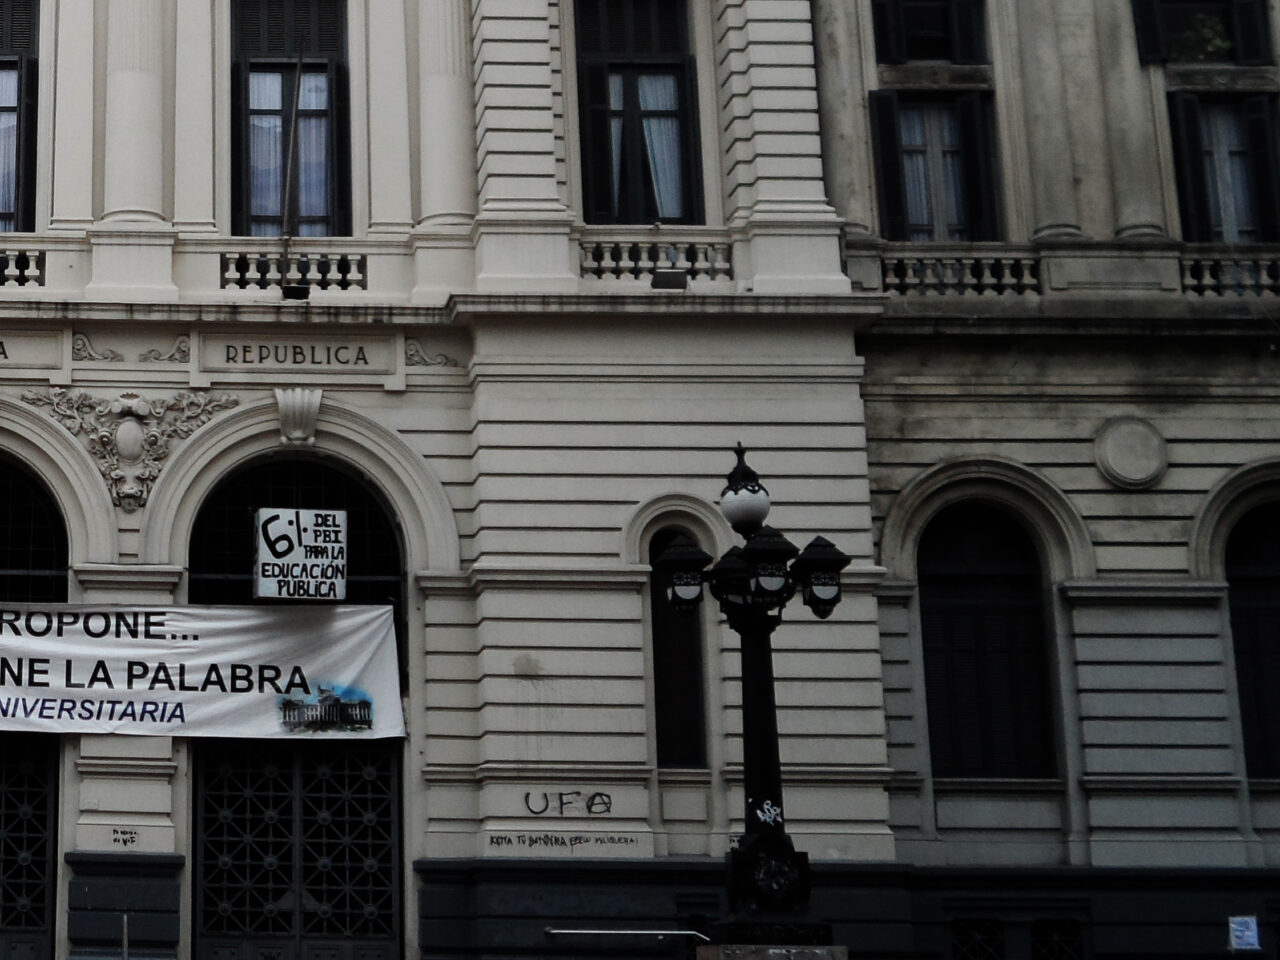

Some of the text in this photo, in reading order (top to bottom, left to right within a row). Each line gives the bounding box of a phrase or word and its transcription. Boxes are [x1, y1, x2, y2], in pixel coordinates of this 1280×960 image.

[225, 344, 370, 366] REPUBLICA
[313, 513, 341, 528] DEL
[313, 529, 344, 544] PBI
[304, 545, 345, 560] PARA LA
[65, 659, 115, 690] LA
[127, 660, 312, 696] PALABRA
